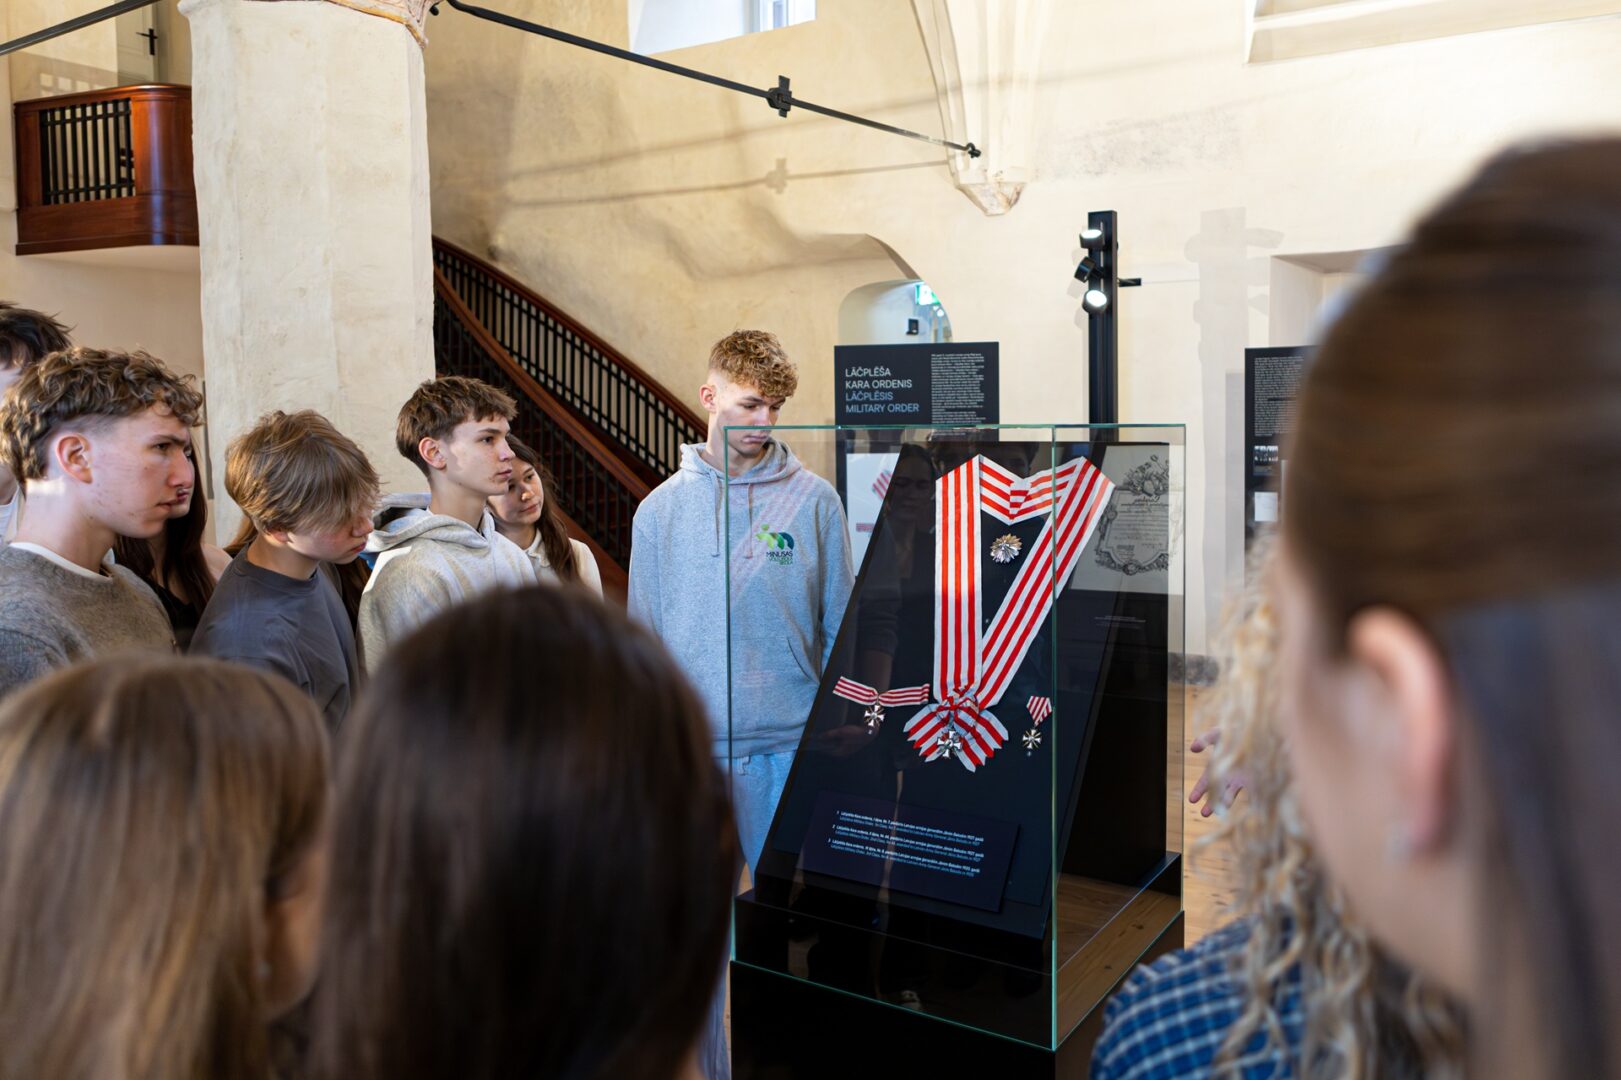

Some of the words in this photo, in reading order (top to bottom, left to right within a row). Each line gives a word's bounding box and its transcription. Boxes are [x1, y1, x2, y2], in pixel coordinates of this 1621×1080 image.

[845, 366, 891, 377] LĀČPLĒŠA
[845, 380, 870, 389] KARA
[872, 379, 912, 389] ORDENIS
[845, 390, 893, 401] LĀČPLĒSIS
[845, 403, 885, 413] MILITARY
[887, 403, 919, 413] ORDER
